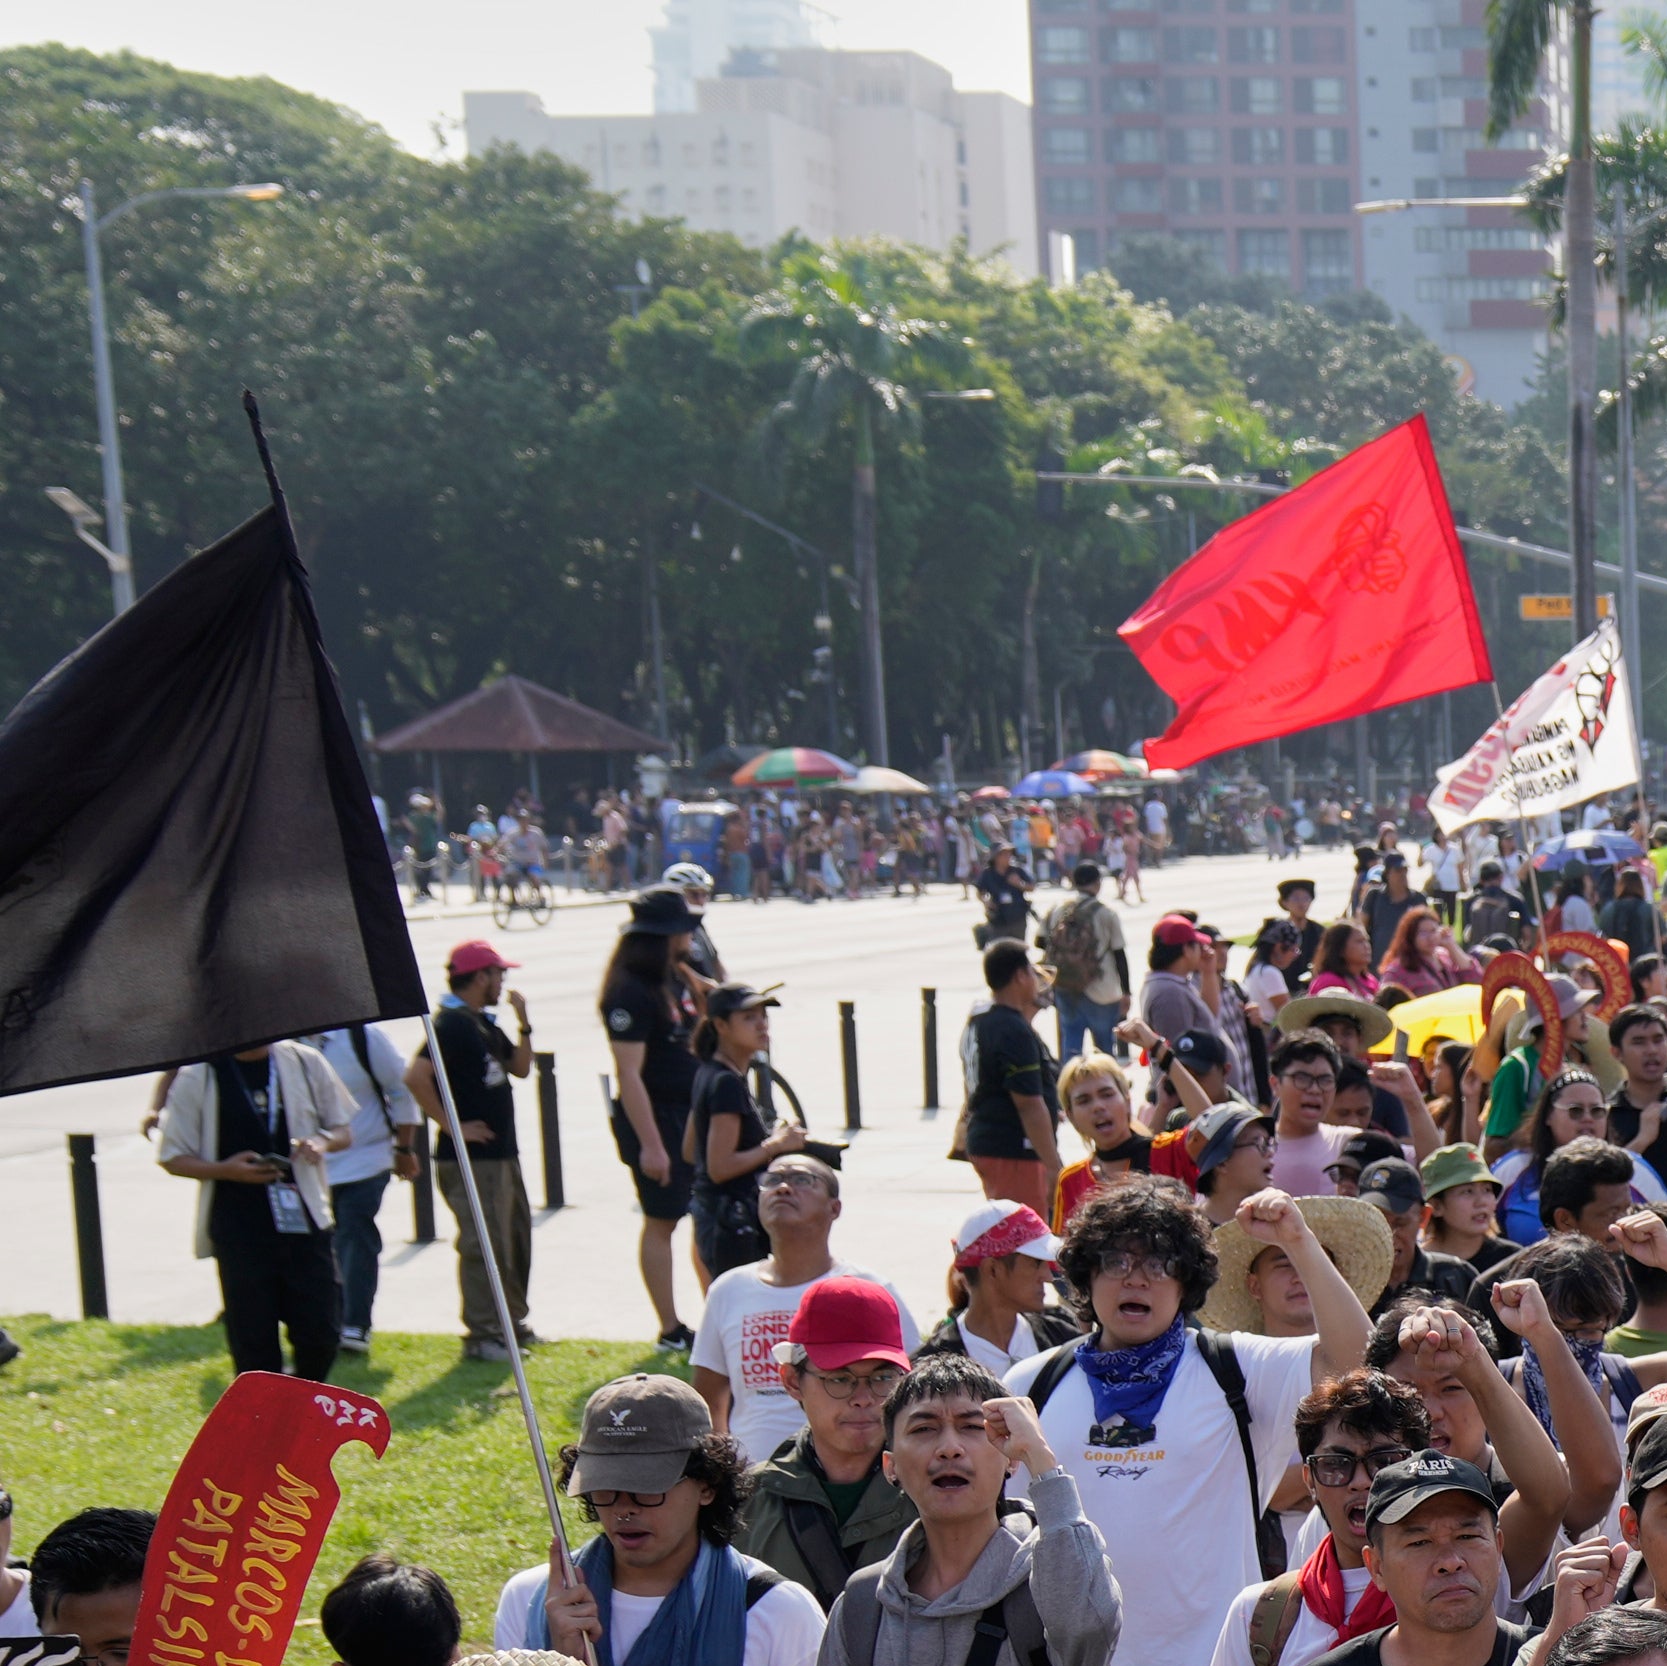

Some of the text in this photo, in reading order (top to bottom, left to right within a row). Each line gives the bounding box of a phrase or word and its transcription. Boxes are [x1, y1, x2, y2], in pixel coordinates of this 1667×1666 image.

[313, 1394, 380, 1428] KMP
[1083, 1448, 1166, 1464] GOODYEAR
[1408, 1458, 1455, 1475] PARIS
